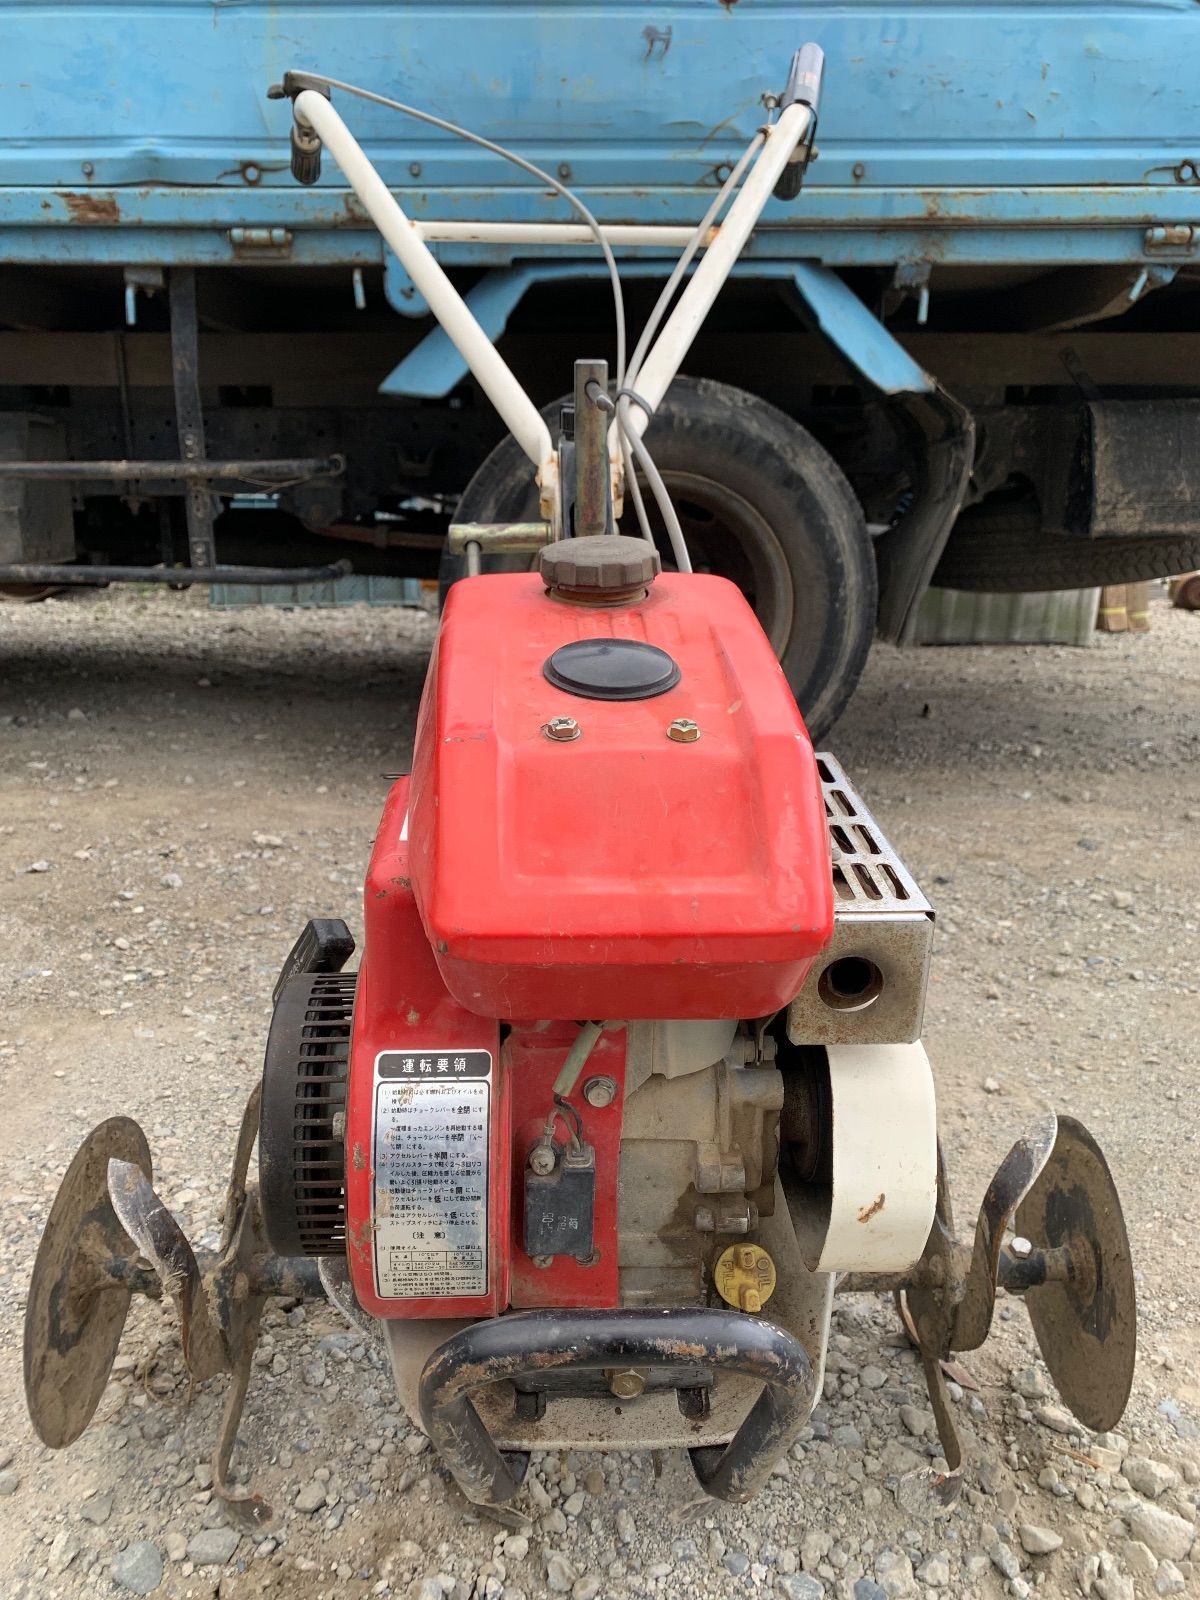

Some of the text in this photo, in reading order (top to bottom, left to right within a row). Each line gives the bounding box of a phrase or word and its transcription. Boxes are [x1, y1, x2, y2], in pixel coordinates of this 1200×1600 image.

[402, 1058, 466, 1073] 運転要領
[721, 1260, 736, 1297] FILL
[757, 1257, 771, 1291] OIL
